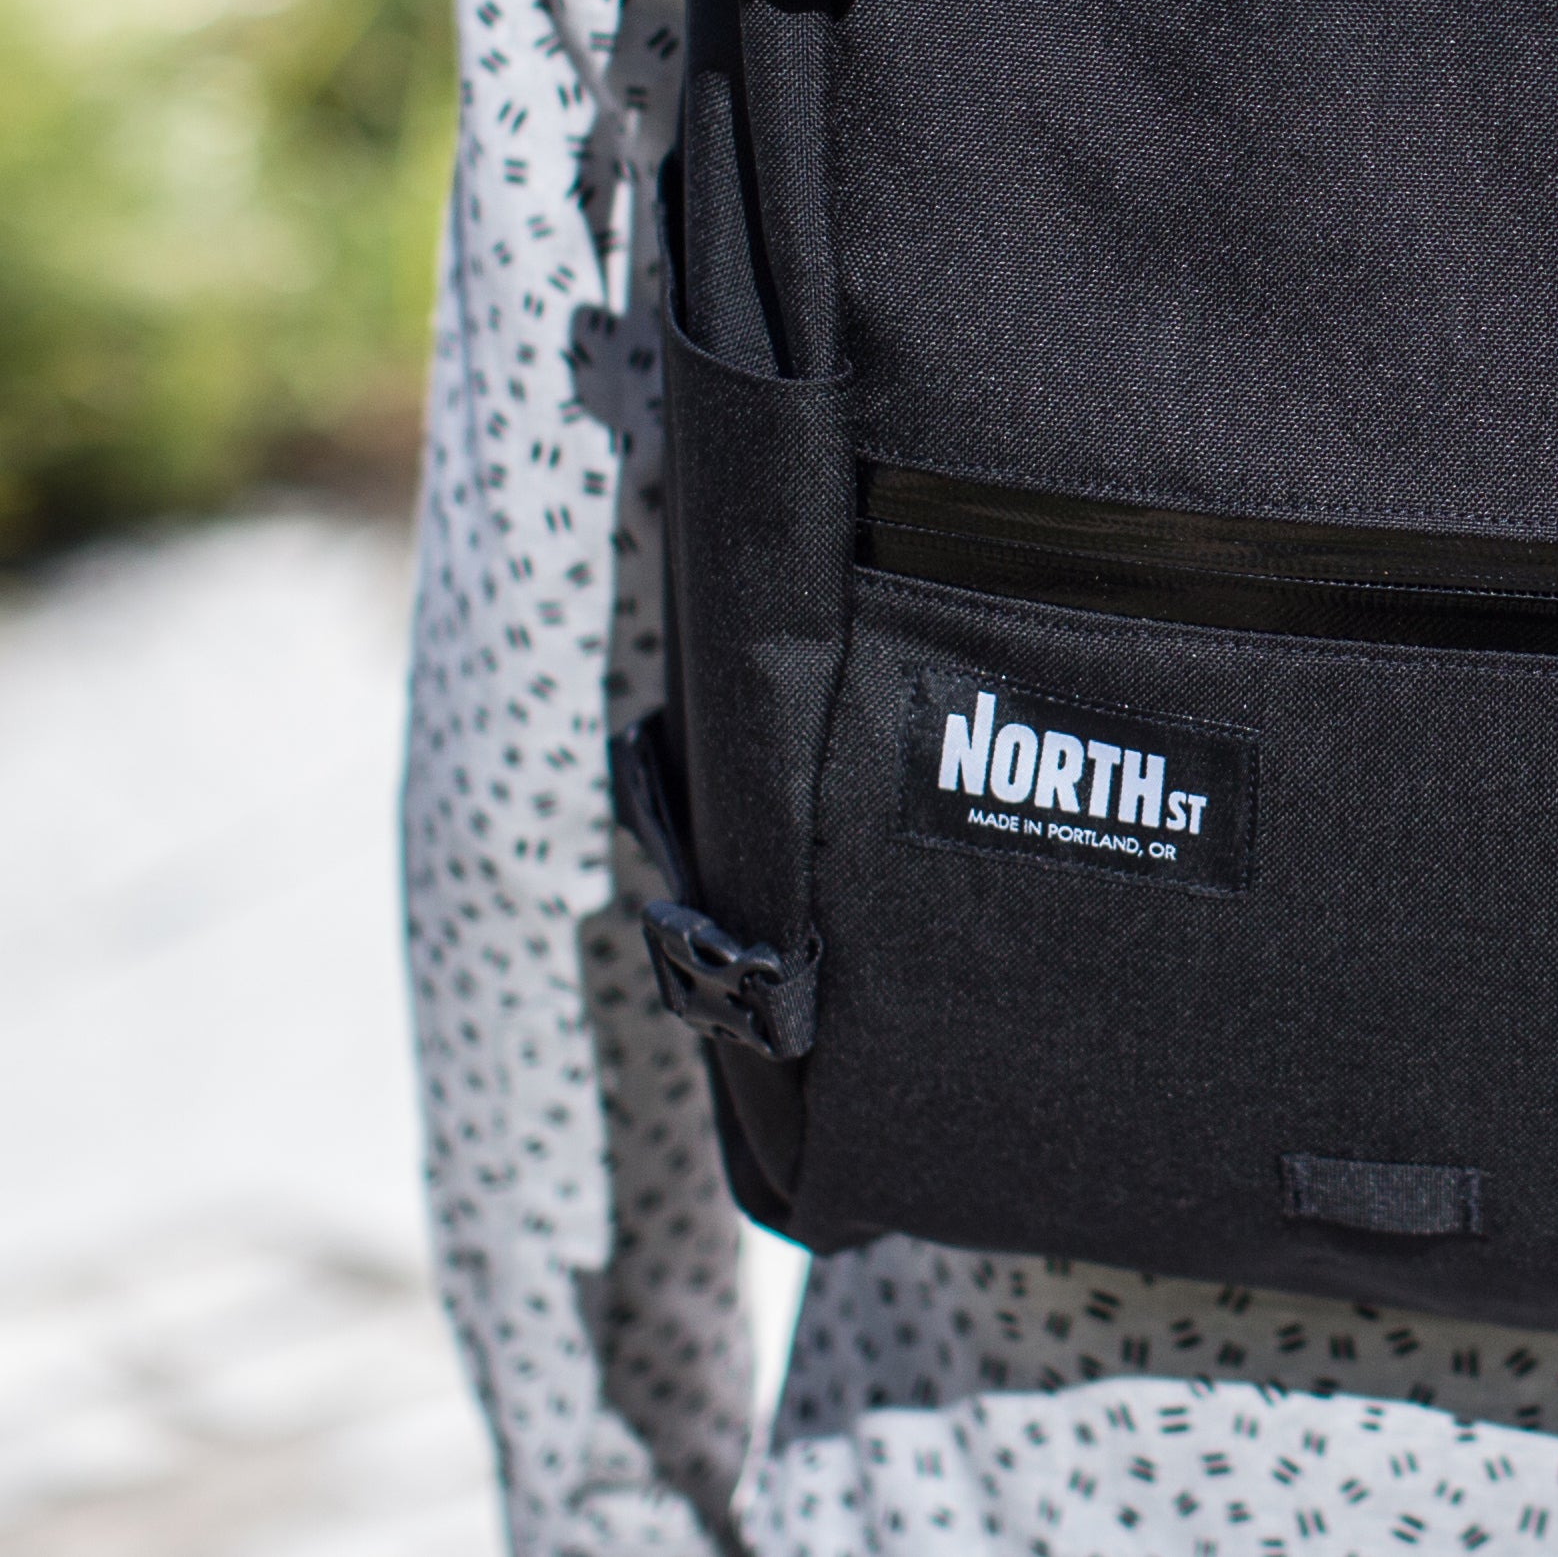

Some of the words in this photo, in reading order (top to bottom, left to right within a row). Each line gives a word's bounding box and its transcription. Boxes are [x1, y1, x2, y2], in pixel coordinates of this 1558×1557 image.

[938, 691, 1166, 828] NORTH
[1166, 791, 1207, 834] ST
[968, 809, 1019, 833] MADE
[1024, 818, 1042, 836] IN
[1048, 824, 1143, 857] PORTLAND,
[1149, 842, 1176, 860] OR
